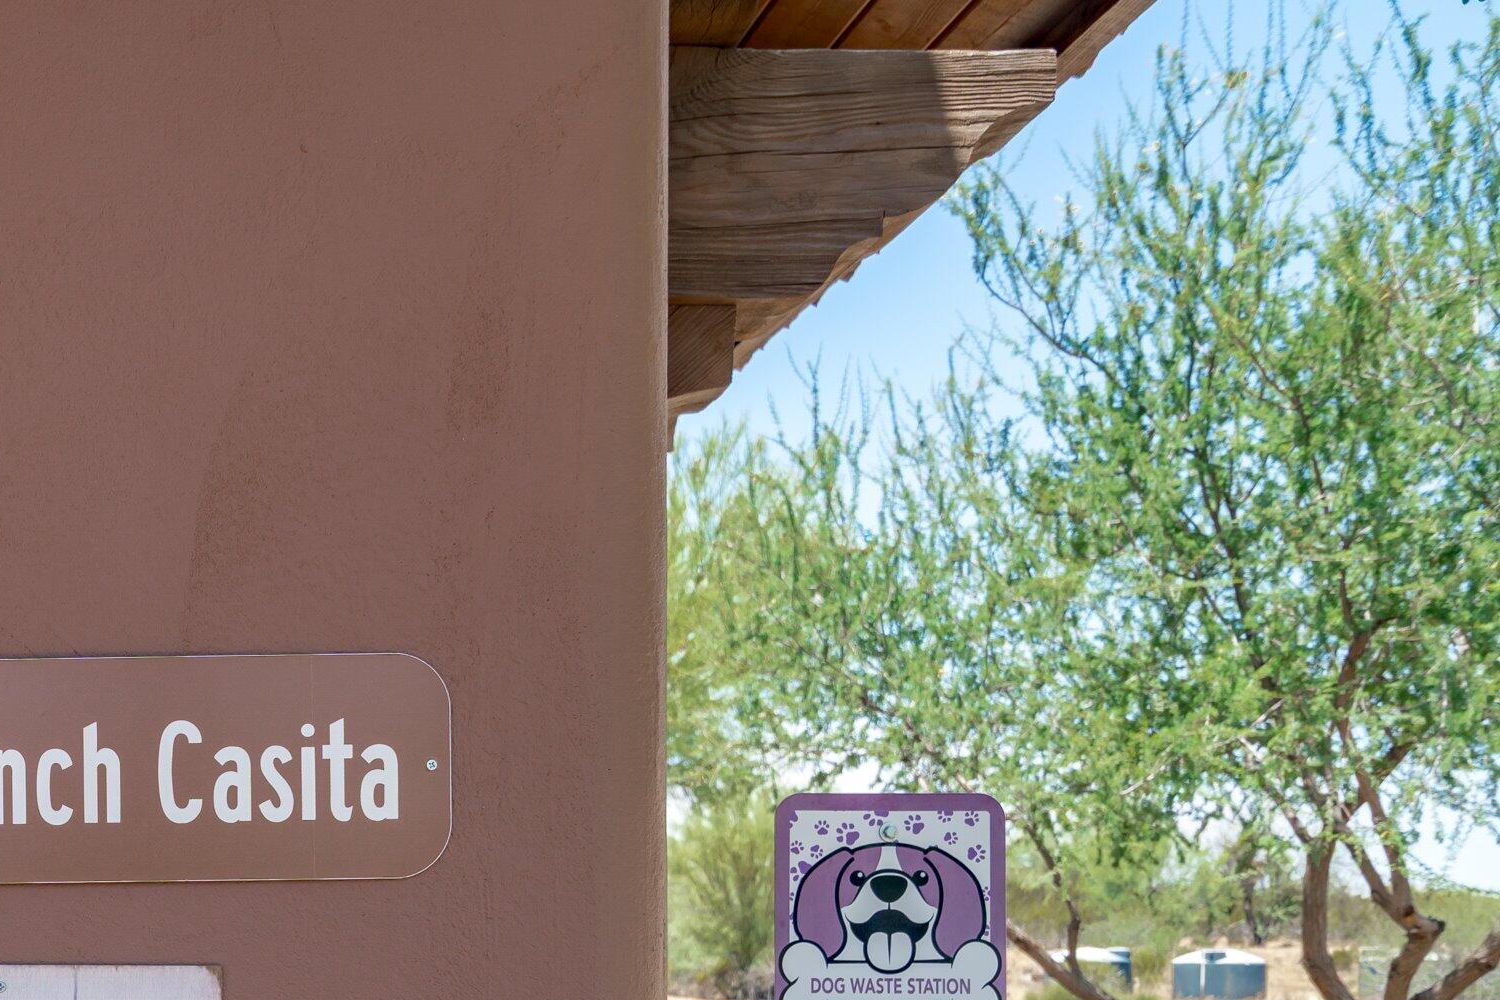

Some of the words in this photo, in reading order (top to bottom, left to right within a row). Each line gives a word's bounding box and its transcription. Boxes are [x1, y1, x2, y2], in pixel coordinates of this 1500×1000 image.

[157, 717, 400, 825] Casita
[810, 977, 846, 994] DOG
[850, 977, 902, 995] WASTE
[907, 977, 971, 995] STATION
